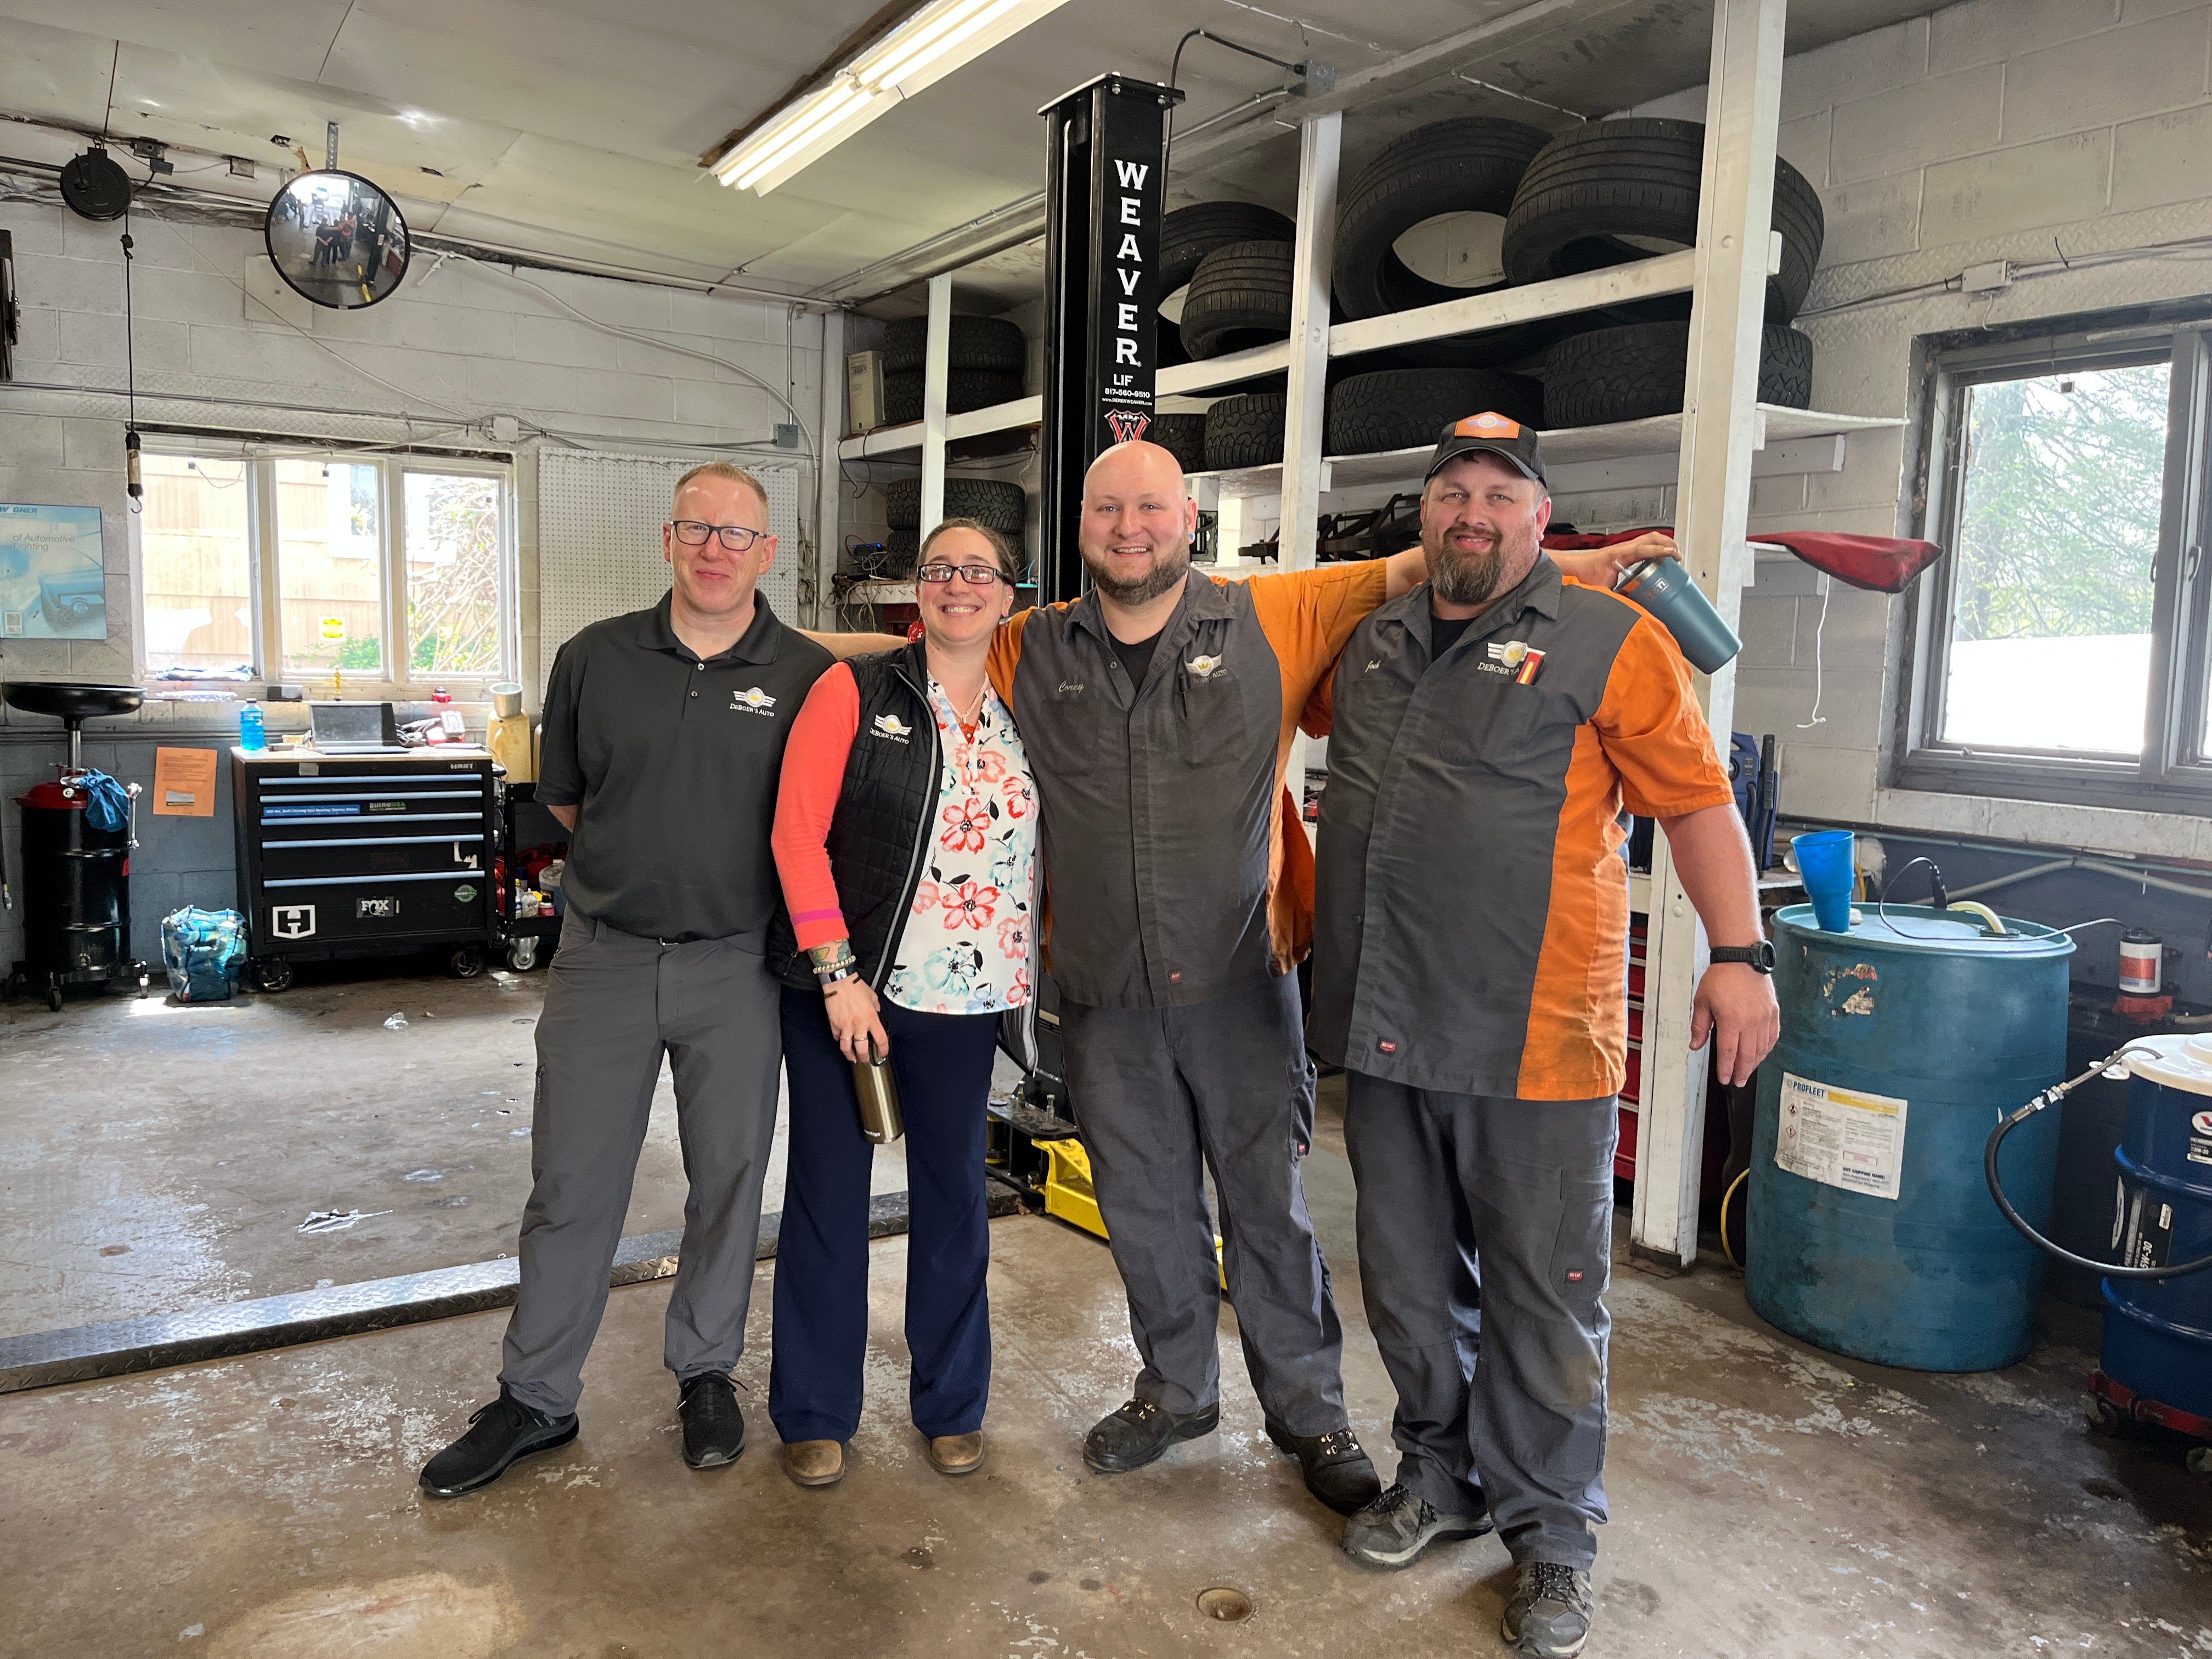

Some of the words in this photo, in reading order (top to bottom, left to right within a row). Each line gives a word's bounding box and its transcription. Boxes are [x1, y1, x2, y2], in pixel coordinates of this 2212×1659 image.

[1114, 159, 1148, 366] WEAVER
[1105, 388, 1150, 398] 817-560-9510
[24, 534, 75, 543] Automotive
[14, 543, 49, 552] Lighting
[1212, 669, 1227, 679] AUTO
[1059, 680, 1084, 694] Corey
[759, 709, 775, 717] AUTO
[894, 736, 910, 744] AUTO
[1793, 1081, 1825, 1097] PROFLEET
